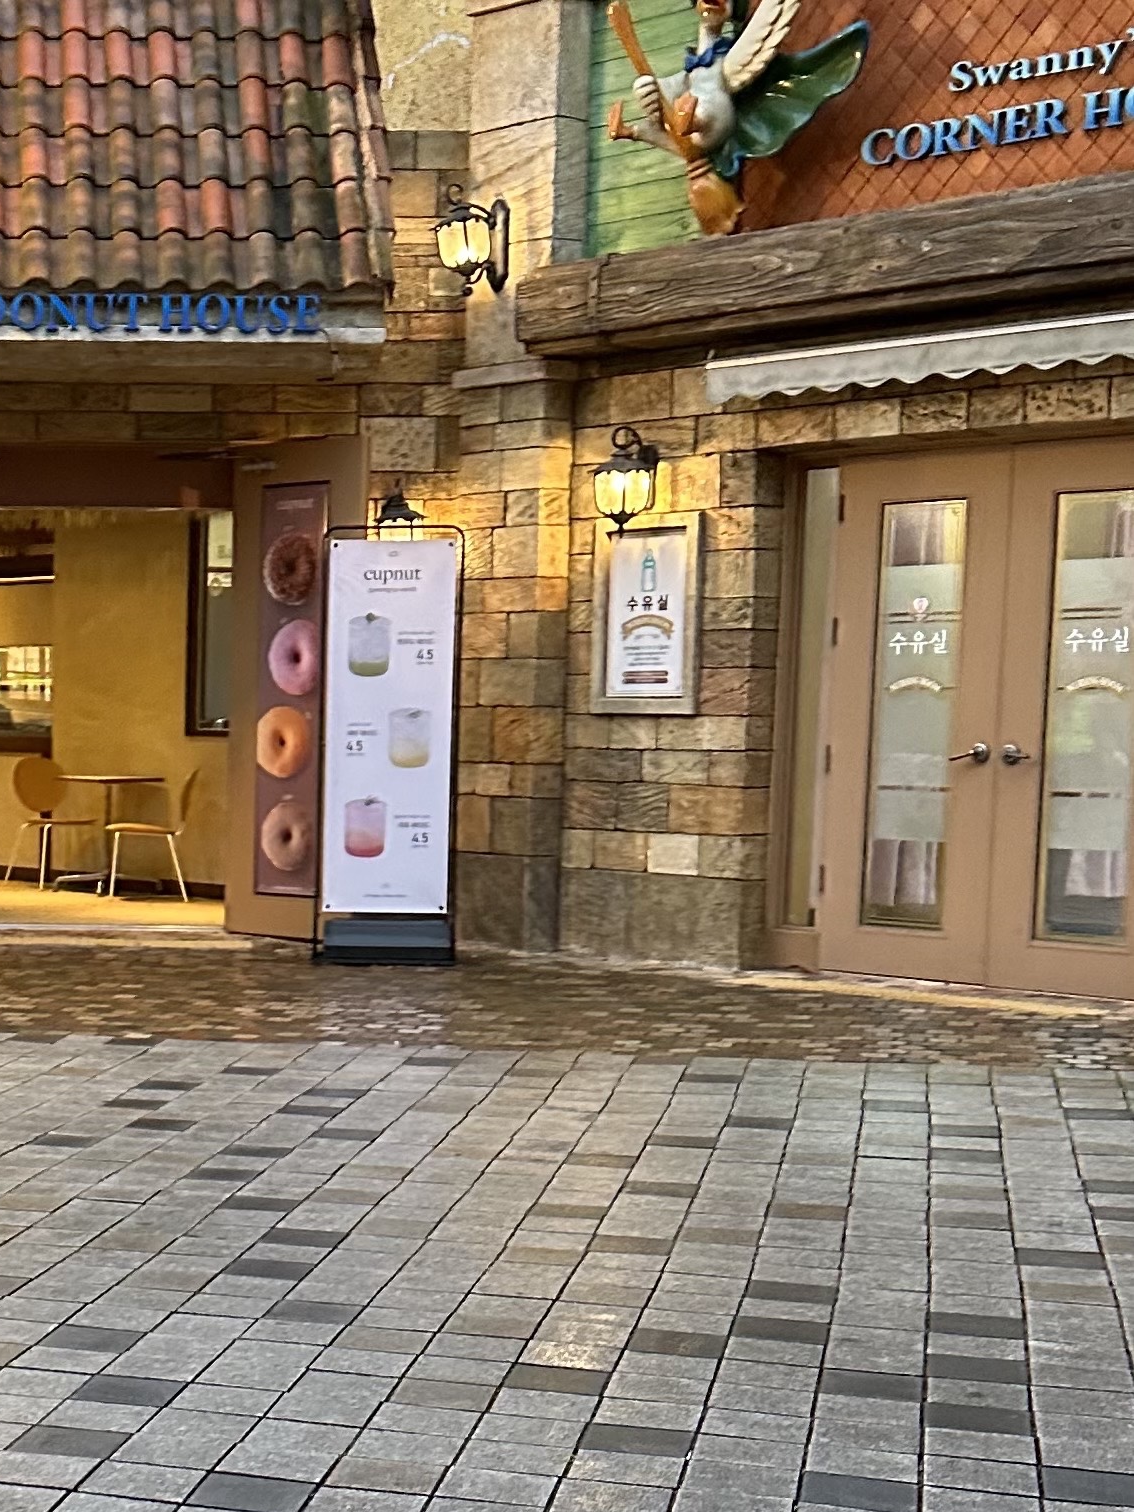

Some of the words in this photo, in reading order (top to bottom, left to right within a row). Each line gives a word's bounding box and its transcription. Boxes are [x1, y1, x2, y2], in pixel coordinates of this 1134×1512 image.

[860, 98, 1068, 166] CORNER
[157, 291, 321, 335] HOUSE
[363, 568, 422, 585] cupnut
[626, 594, 669, 612] 수유실
[888, 629, 948, 655] 수유실
[1064, 626, 1129, 653] 수유실
[411, 832, 429, 844] 4.5
